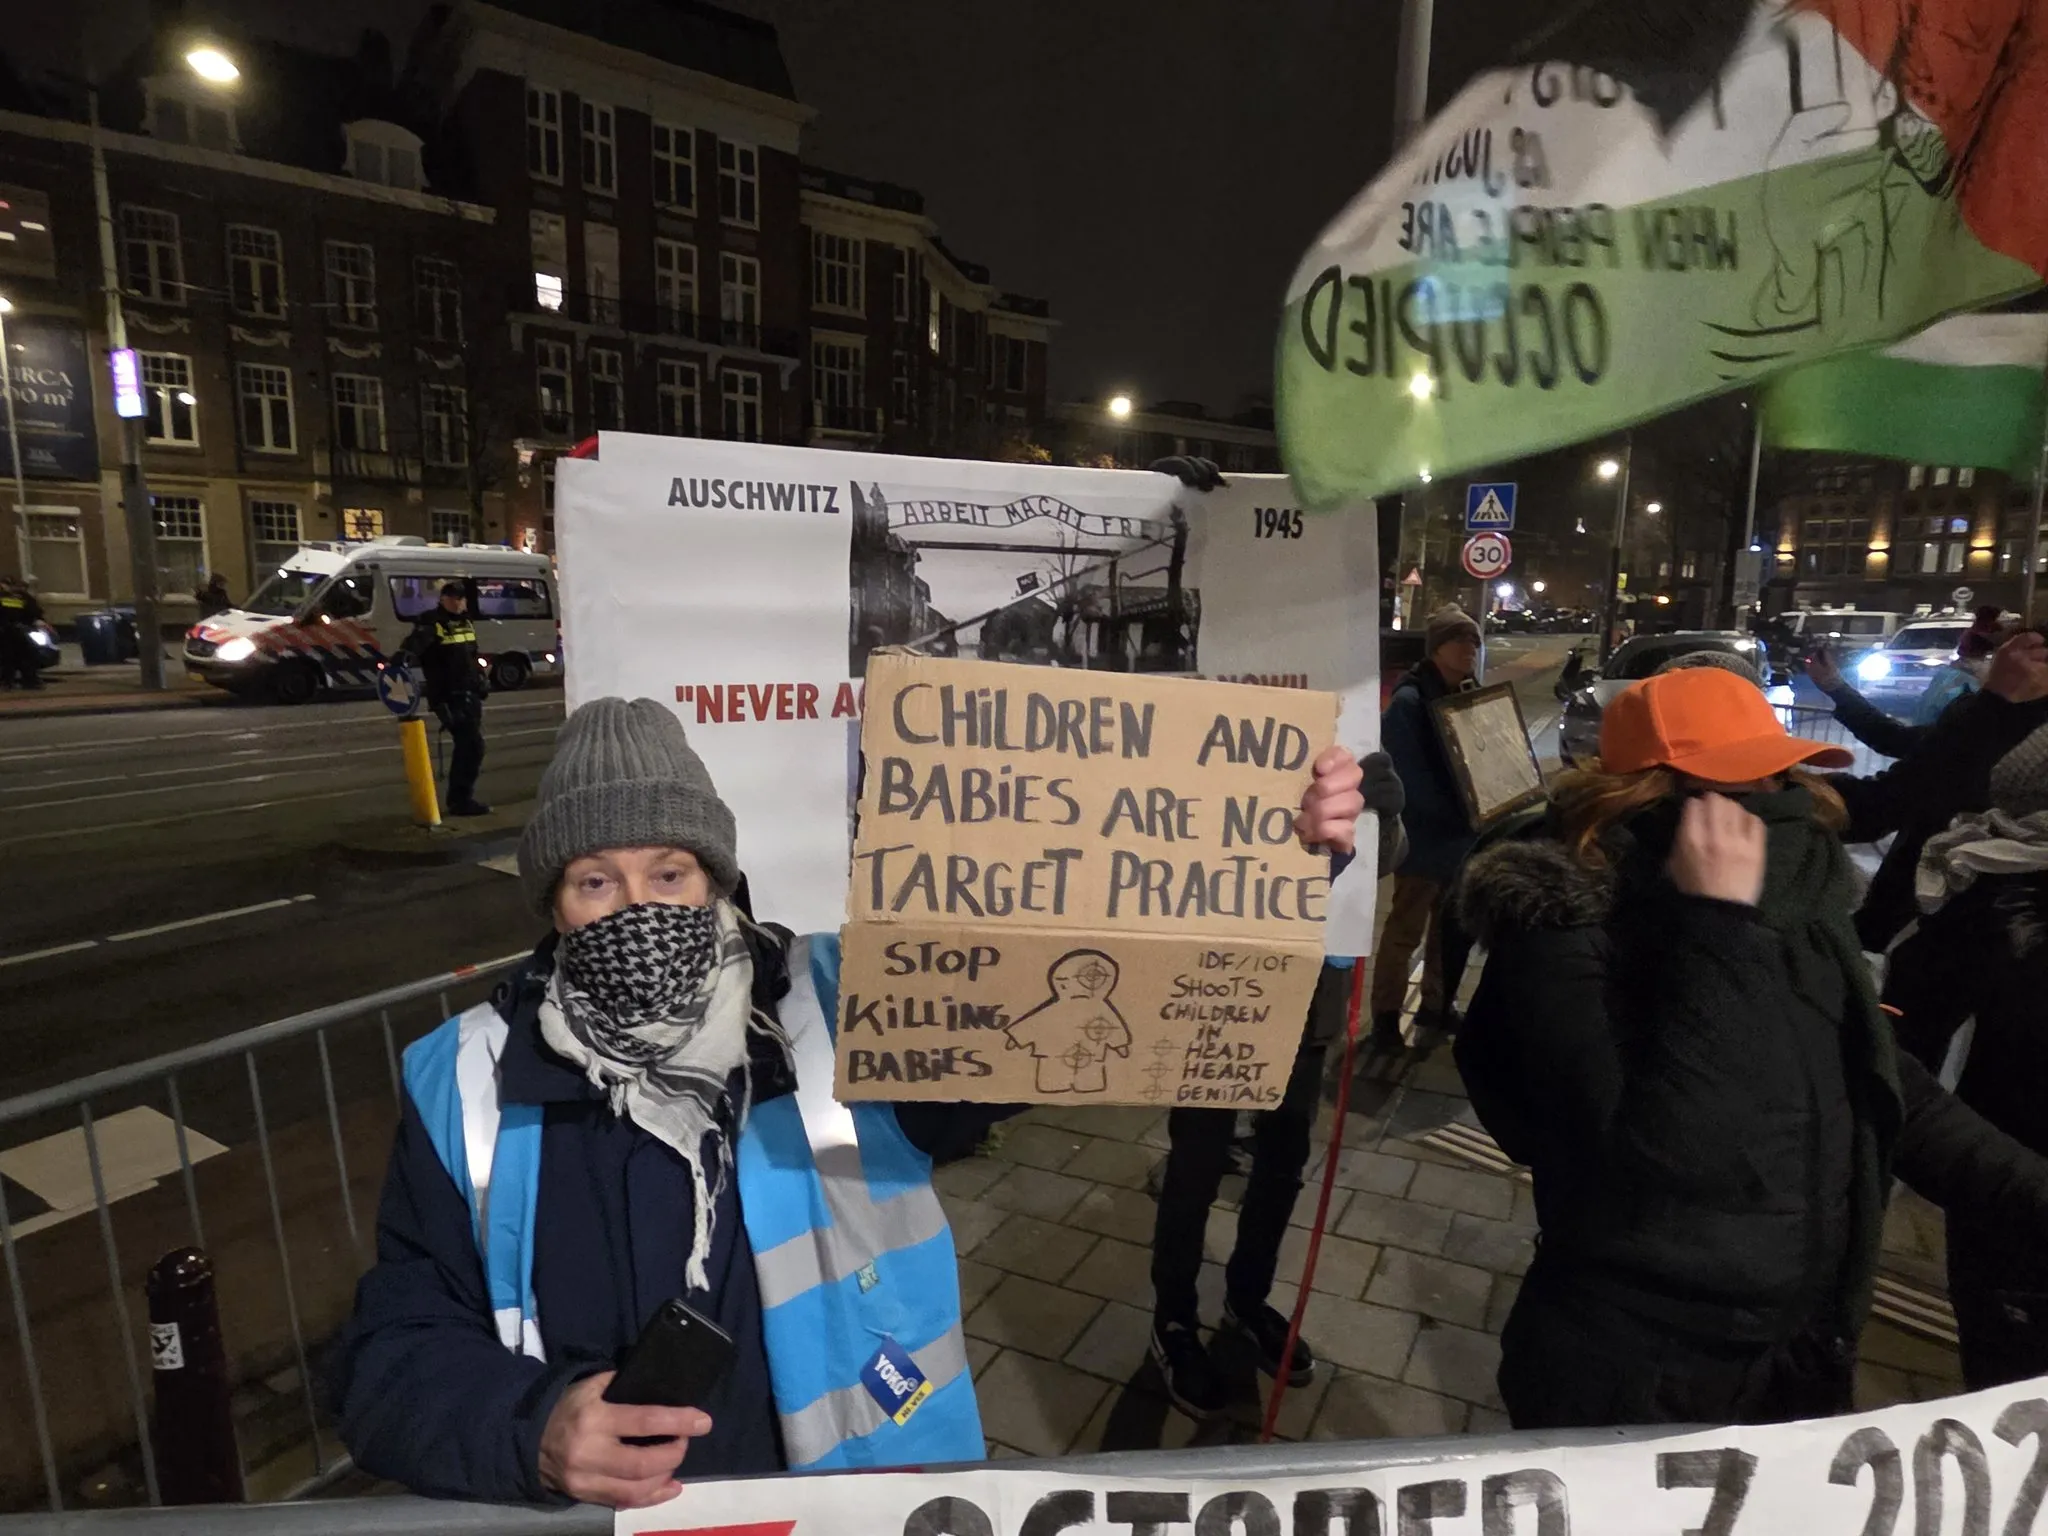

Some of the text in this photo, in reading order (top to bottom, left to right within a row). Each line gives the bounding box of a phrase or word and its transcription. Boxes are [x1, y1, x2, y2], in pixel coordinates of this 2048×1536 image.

[667, 477, 840, 514] AUSCHWITZ
[904, 502, 990, 525] ARBEIT
[1006, 497, 1087, 529] MACHT
[1254, 508, 1304, 539] 1945
[1472, 546, 1502, 563] 30
[675, 682, 865, 724] "NEVER A
[1197, 713, 1309, 772] AND
[1100, 786, 1202, 842] ARE
[1221, 795, 1305, 848] NO
[857, 843, 1083, 917] TARGET
[1170, 974, 1265, 998] SHOOTS
[1197, 1024, 1222, 1041] IN
[1185, 1042, 1256, 1061] HEAD
[1182, 1062, 1270, 1082] HEART
[874, 1353, 909, 1396] YOKO
